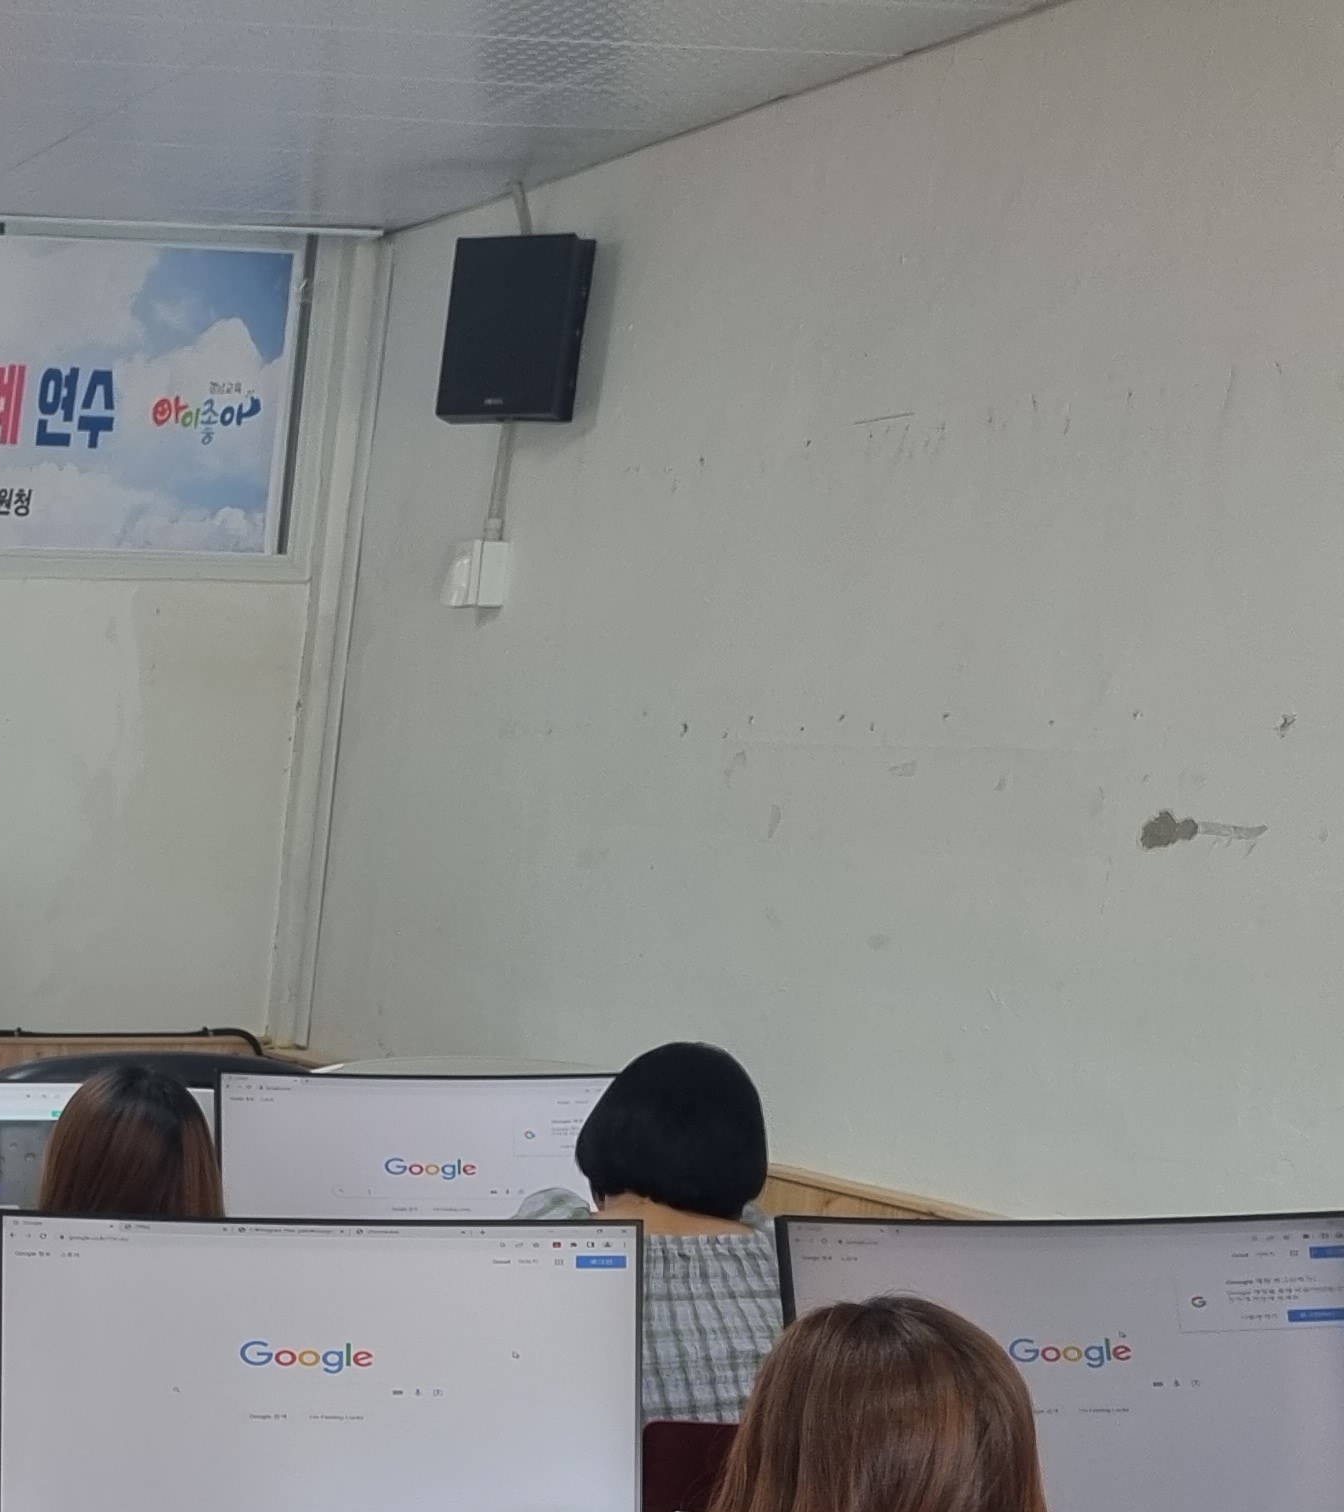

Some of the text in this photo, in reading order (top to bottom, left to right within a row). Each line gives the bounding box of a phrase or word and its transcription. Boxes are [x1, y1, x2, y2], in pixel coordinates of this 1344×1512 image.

[36, 366, 115, 448] 연수
[384, 1158, 476, 1180] Google
[240, 1340, 373, 1374] Google
[1009, 1338, 1131, 1368] Google
